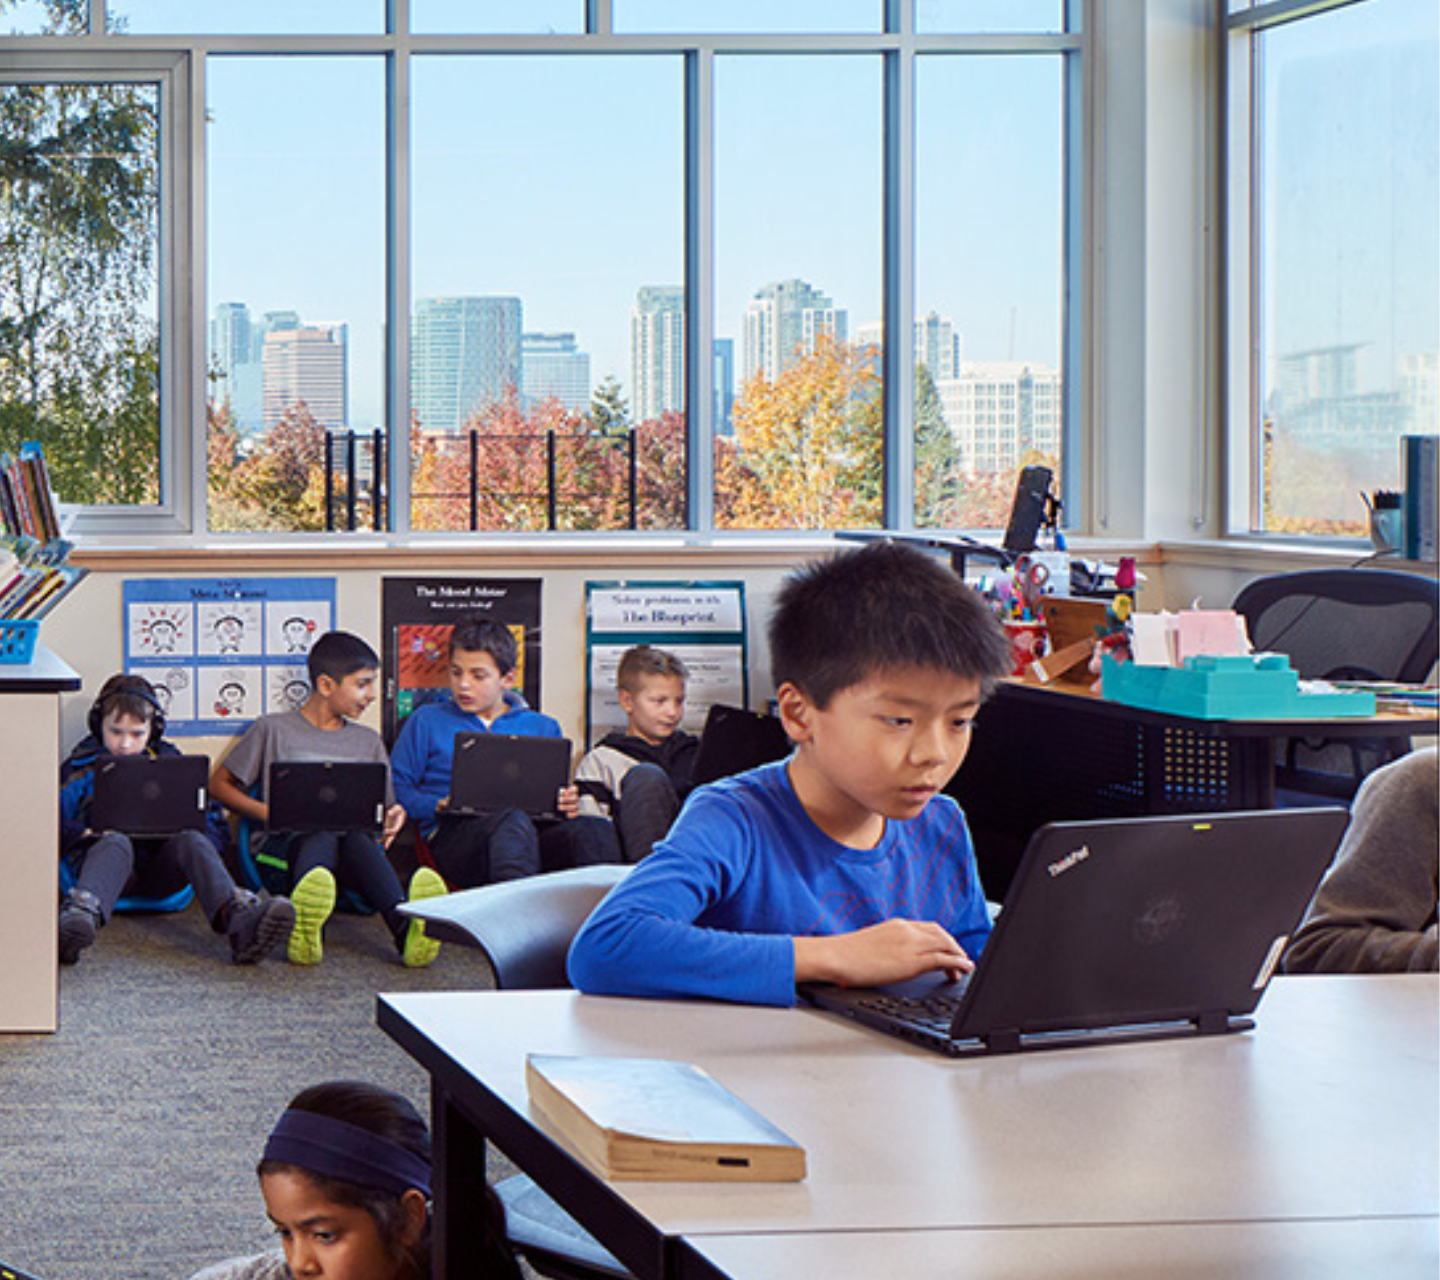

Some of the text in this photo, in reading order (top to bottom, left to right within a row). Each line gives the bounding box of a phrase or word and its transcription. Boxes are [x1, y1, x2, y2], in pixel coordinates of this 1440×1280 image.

[416, 585, 508, 598] The Mood Meter
[643, 595, 692, 608] problems
[623, 609, 717, 626] The Blueprint
[1048, 845, 1090, 878] ThinkPad
